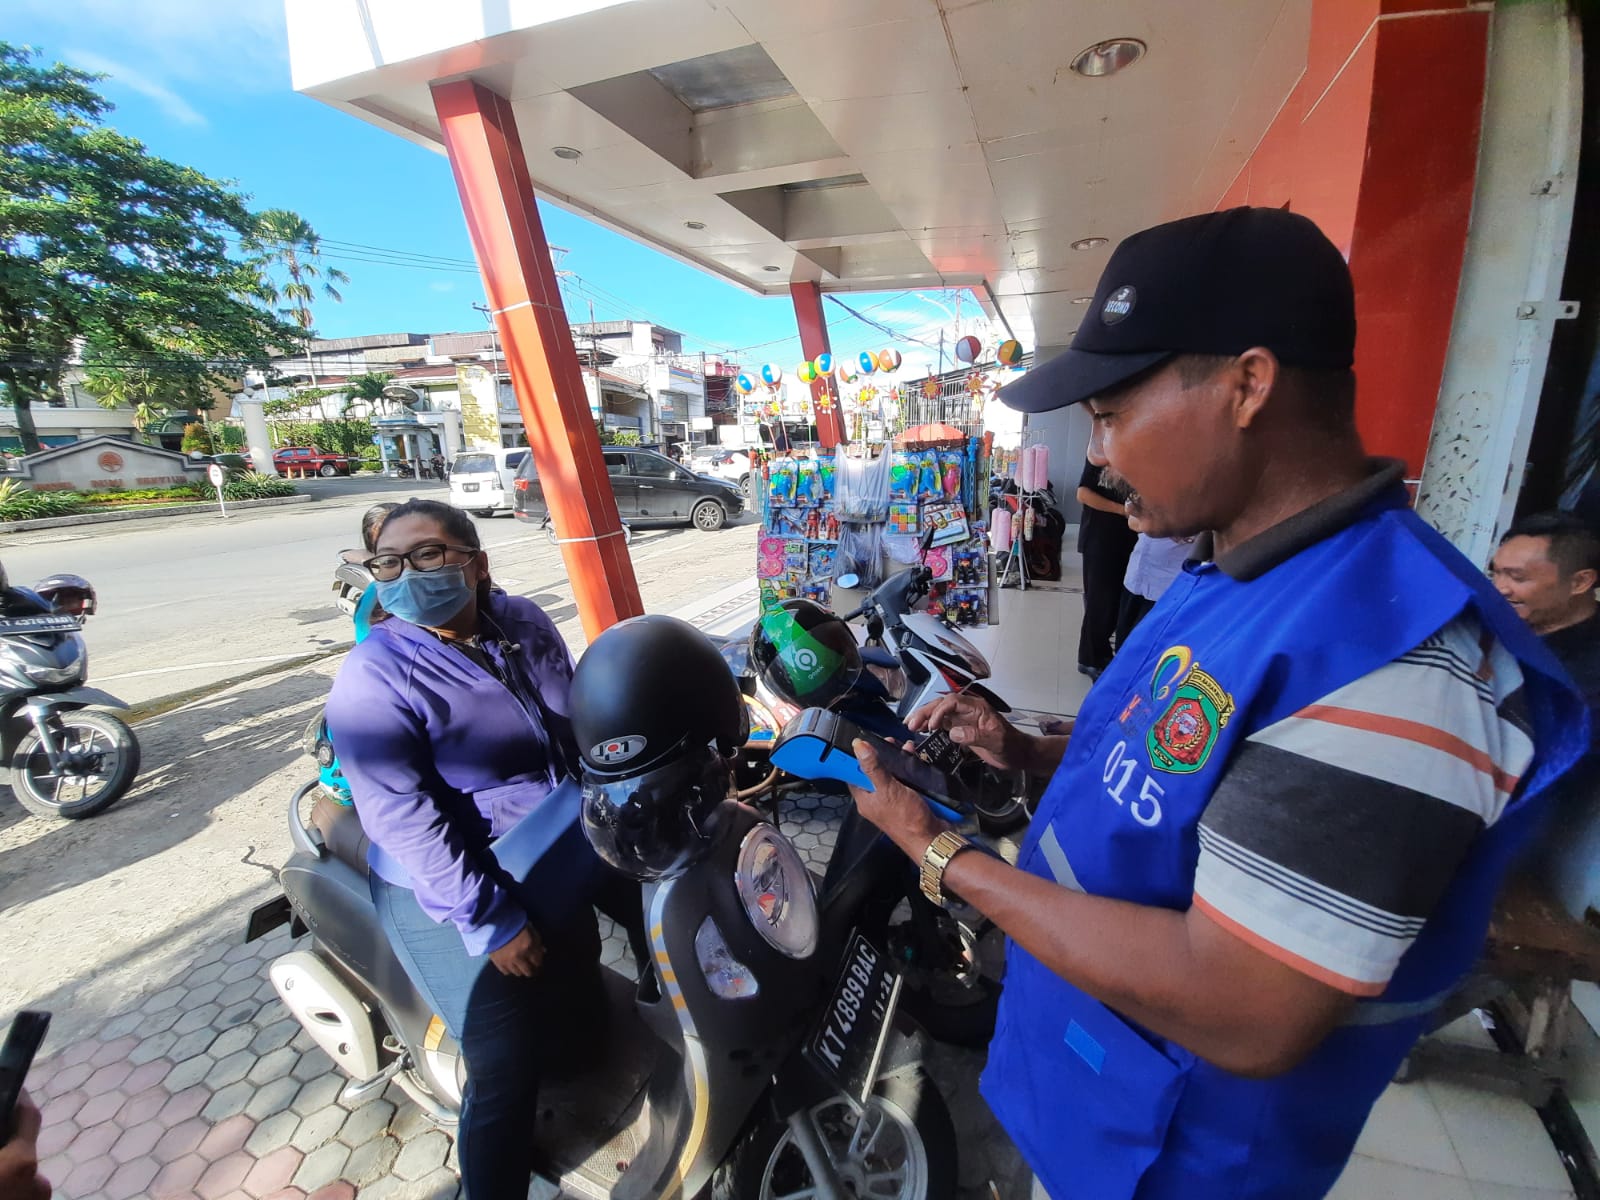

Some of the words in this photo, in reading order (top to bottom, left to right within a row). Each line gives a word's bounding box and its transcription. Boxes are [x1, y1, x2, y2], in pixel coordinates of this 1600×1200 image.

[1102, 740, 1165, 827] 015
[820, 1025, 846, 1069] KT
[833, 978, 866, 1035] 4899
[850, 944, 877, 987] BAC
